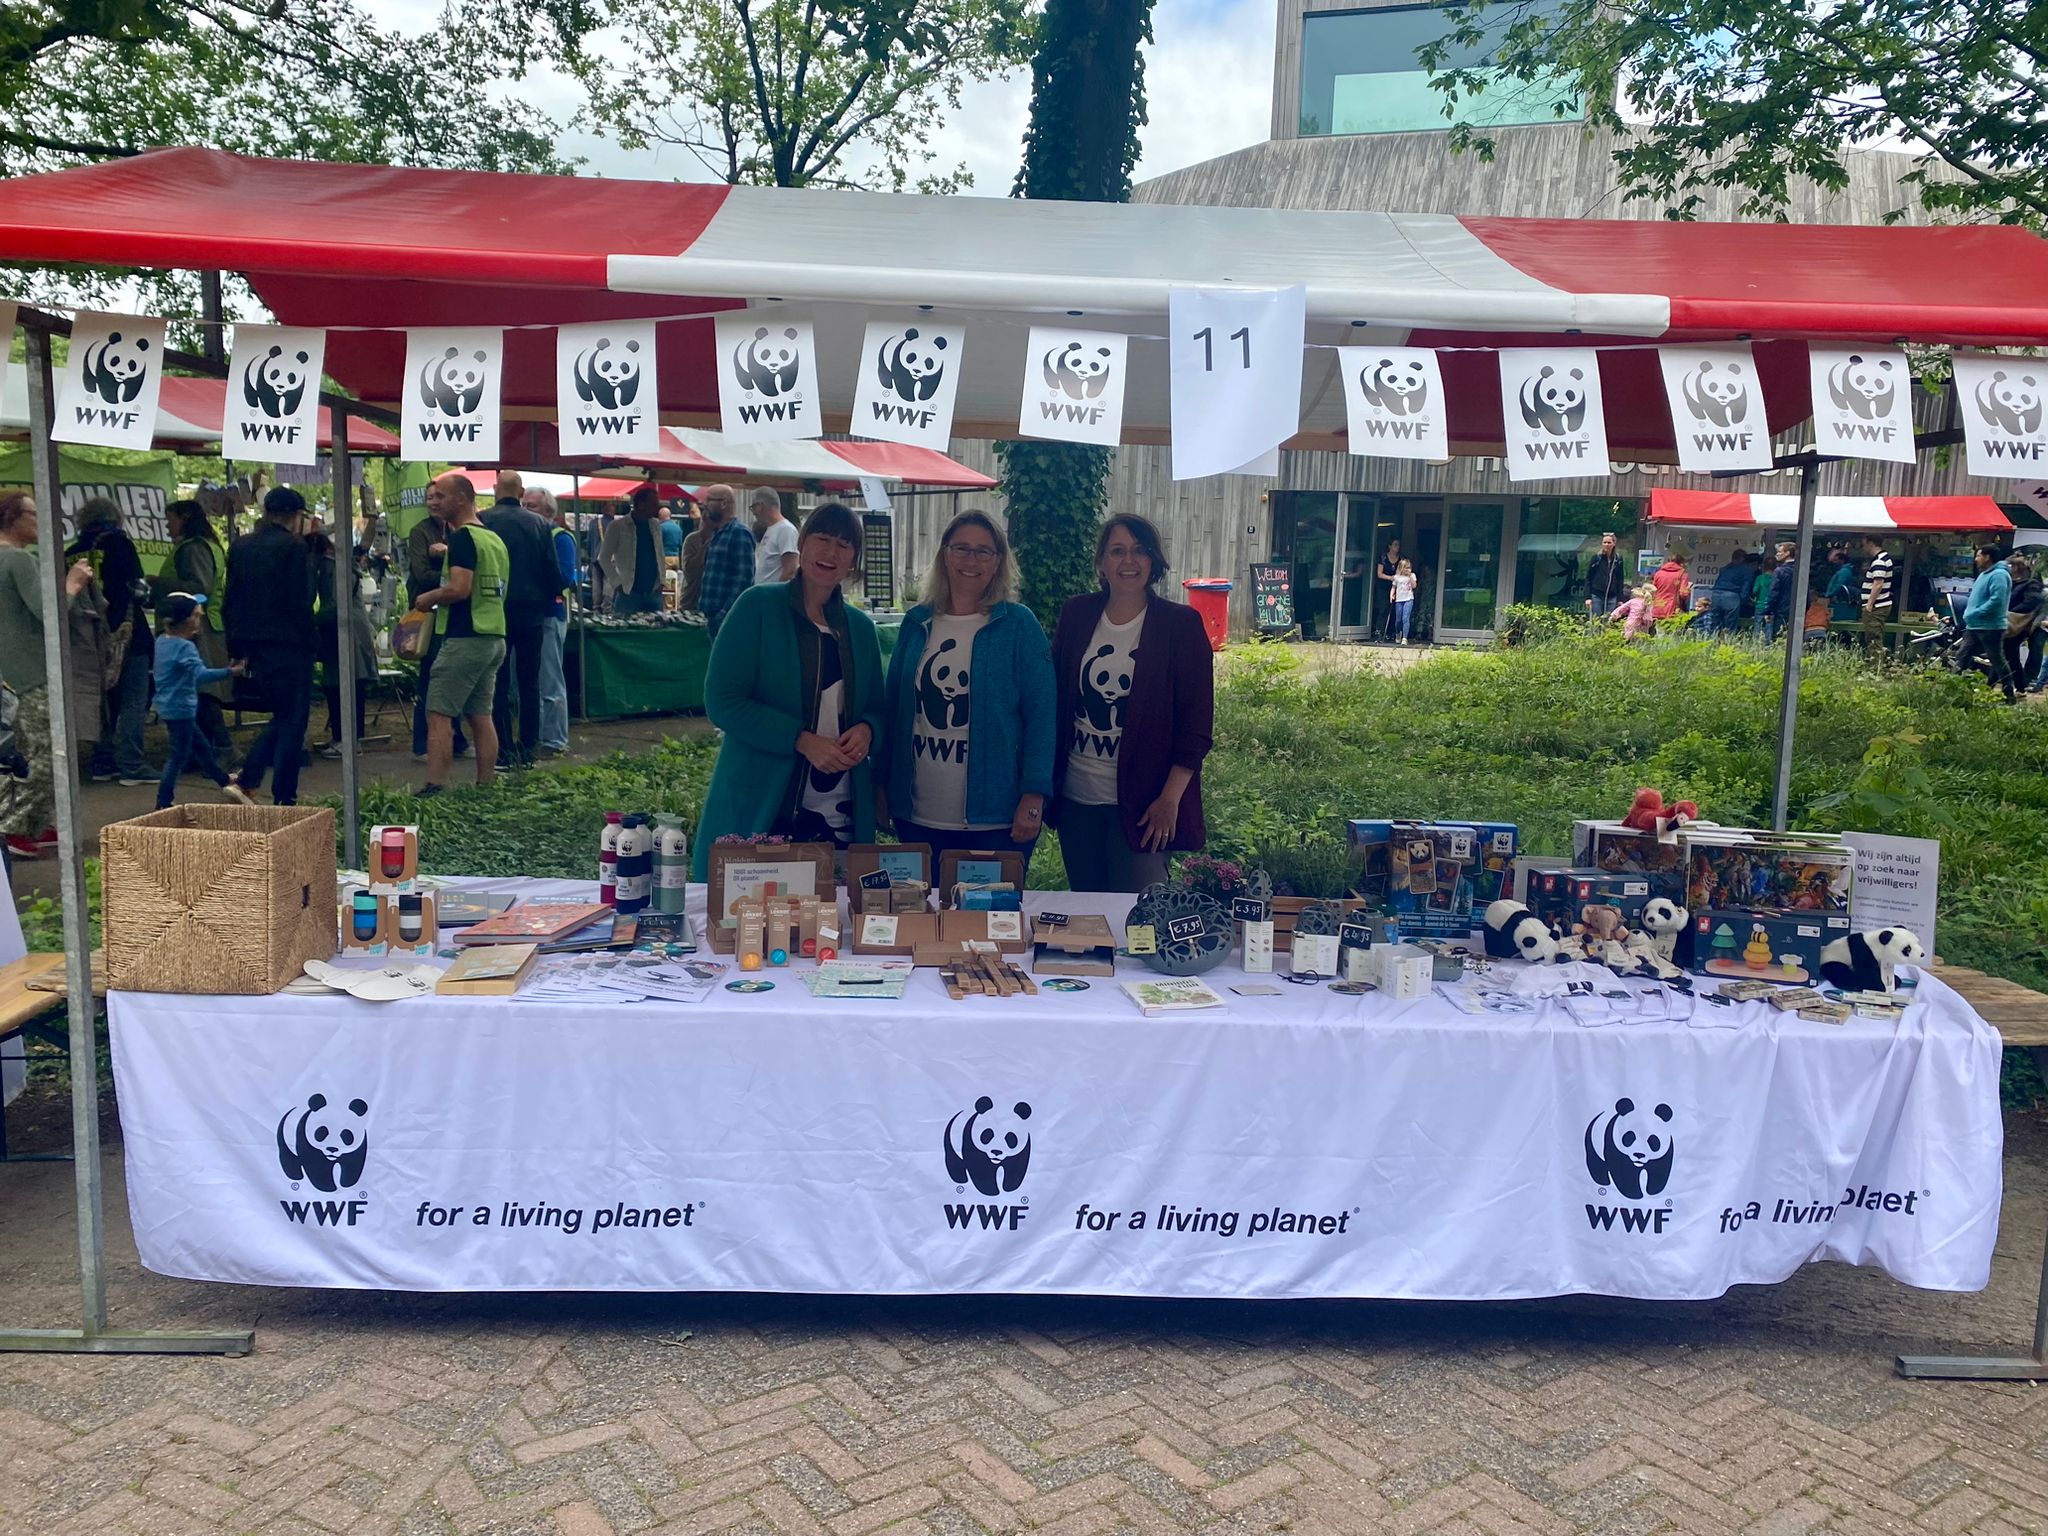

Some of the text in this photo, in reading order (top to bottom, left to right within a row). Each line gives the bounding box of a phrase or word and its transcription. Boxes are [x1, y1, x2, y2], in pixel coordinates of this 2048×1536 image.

[1193, 327, 1251, 372] 11
[76, 407, 140, 430] WWF
[738, 400, 803, 425] WWF
[872, 401, 937, 429] WWF
[1039, 401, 1106, 426] WWF
[241, 422, 302, 445] WWF
[418, 423, 483, 442] WWF
[576, 415, 642, 436] WWF
[1365, 419, 1430, 441] WWF
[1832, 422, 1897, 444] WWF
[1524, 440, 1590, 462] WWF
[1692, 432, 1753, 453] WWF
[1983, 440, 2046, 461] WWF
[864, 483, 871, 493] 3
[1697, 565, 1718, 575] GRO
[1073, 729, 1120, 758] WW
[1857, 849, 1921, 865] Wij zijn altijd
[1857, 864, 1920, 877] op zoek naar
[1857, 876, 1918, 890] vrijwilligers!
[280, 1200, 369, 1227] WWF
[416, 1201, 464, 1227] for
[472, 1206, 491, 1226] a
[500, 1201, 583, 1235] living
[943, 1203, 1030, 1231] WWF
[1075, 1203, 1122, 1232] for
[1127, 1210, 1147, 1230] a
[1156, 1204, 1240, 1238] living
[1584, 1203, 1673, 1234] WWF
[1744, 1201, 1761, 1220] a
